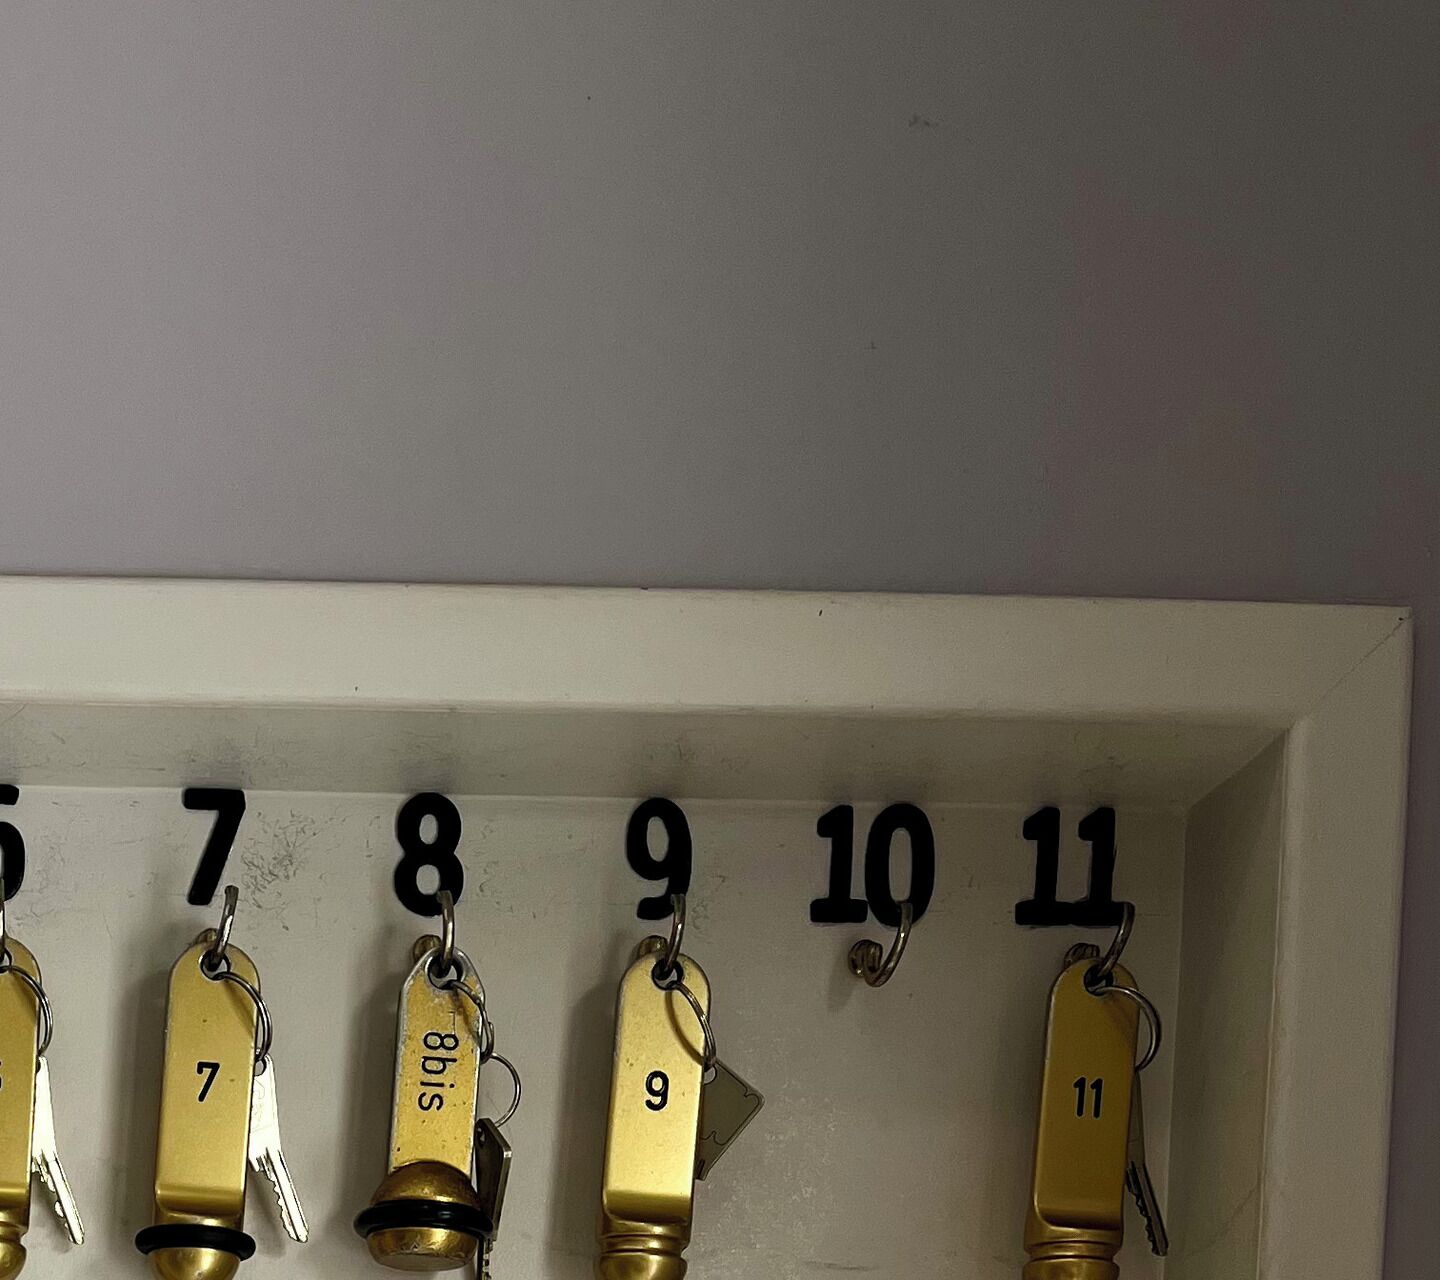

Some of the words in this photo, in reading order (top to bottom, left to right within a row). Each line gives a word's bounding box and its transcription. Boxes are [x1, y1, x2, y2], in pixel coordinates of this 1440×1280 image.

[182, 788, 245, 906] 7
[394, 792, 464, 915] 8
[626, 797, 692, 920] 9
[810, 802, 935, 926] 10
[1015, 806, 1125, 926] 11
[196, 1061, 221, 1102] 7
[417, 1030, 458, 1112] 8bis
[644, 1070, 670, 1111] 9
[1072, 1077, 1103, 1118] 11
